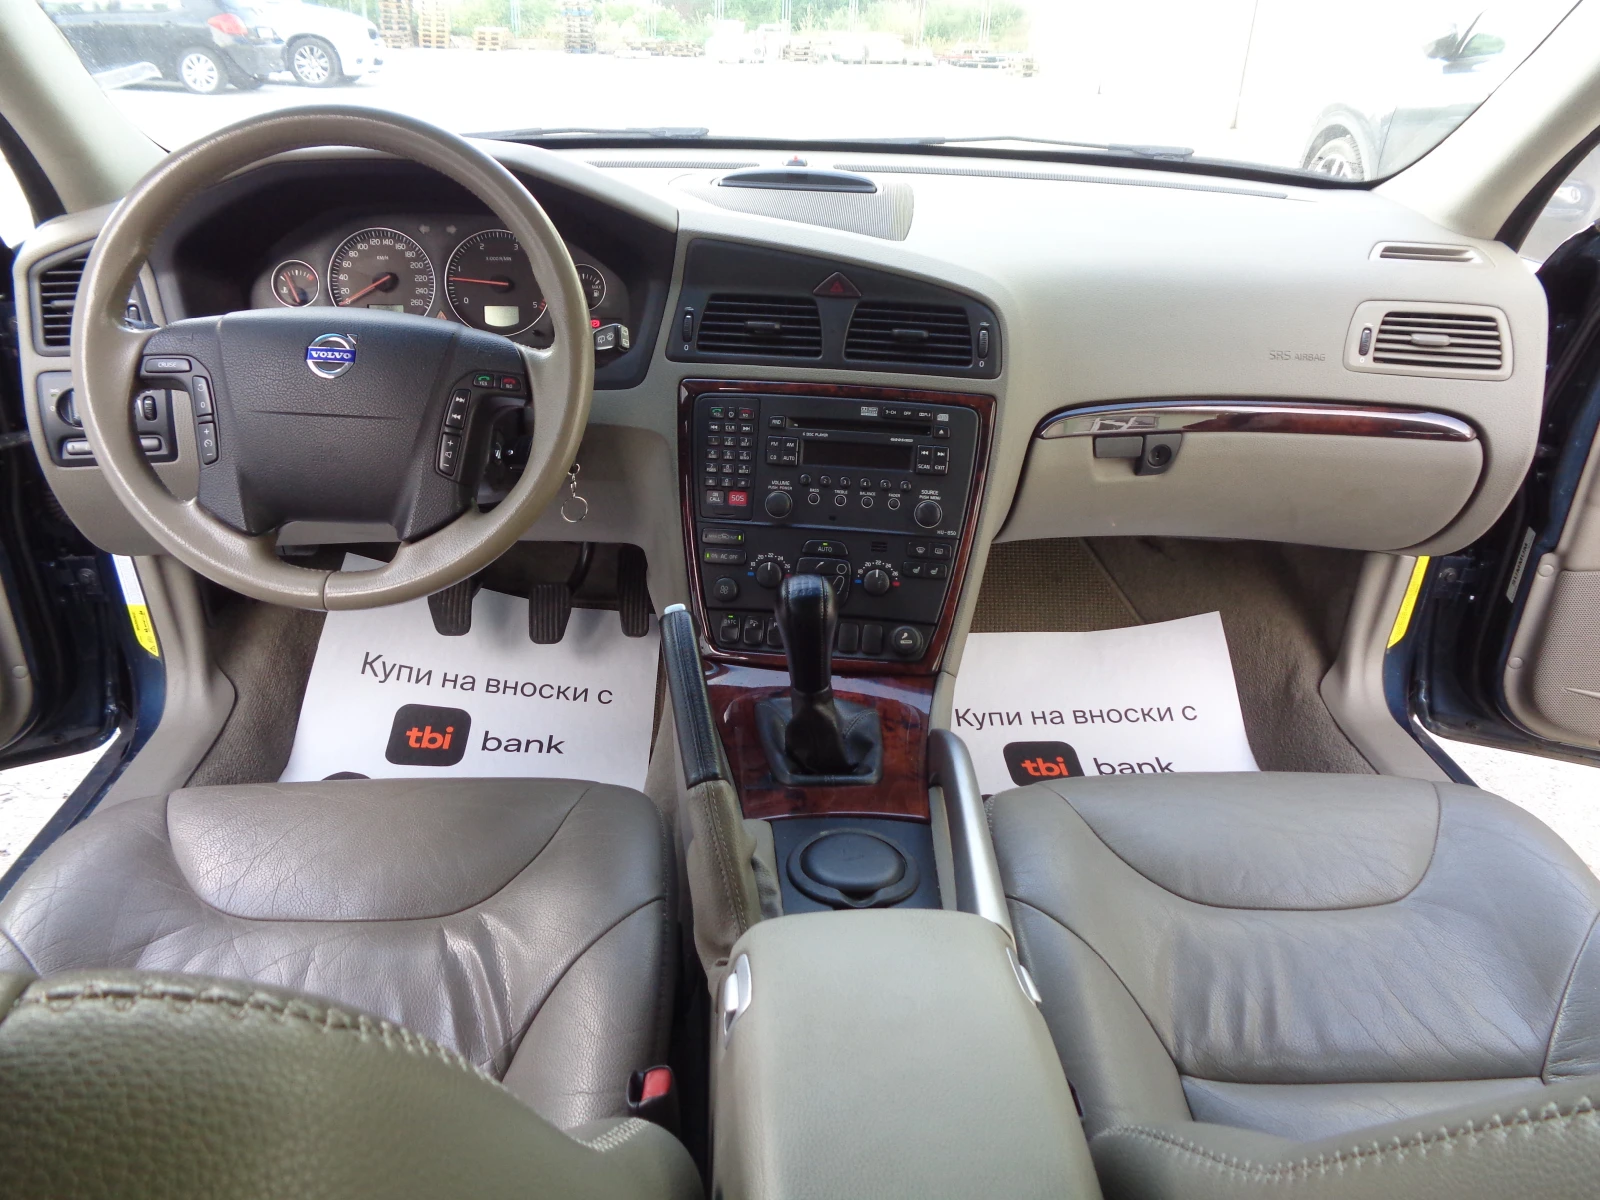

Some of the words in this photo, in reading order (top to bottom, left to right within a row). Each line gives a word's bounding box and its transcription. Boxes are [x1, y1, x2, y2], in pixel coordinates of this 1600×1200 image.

[382, 238, 393, 246] 140
[310, 350, 352, 359] VOLVO
[1269, 350, 1291, 360] SRS
[1294, 353, 1326, 362] AIRBAG
[360, 651, 432, 685] Купи
[441, 672, 476, 692] на
[484, 679, 589, 703] вноски
[597, 689, 614, 705] с
[955, 708, 1023, 731] Купи
[1031, 709, 1065, 726] на
[1073, 706, 1175, 725] вноски
[1181, 705, 1198, 721] с
[405, 726, 455, 751] tbi
[481, 731, 566, 755] bank
[1021, 757, 1069, 777] tbi
[1093, 757, 1175, 776] bank
